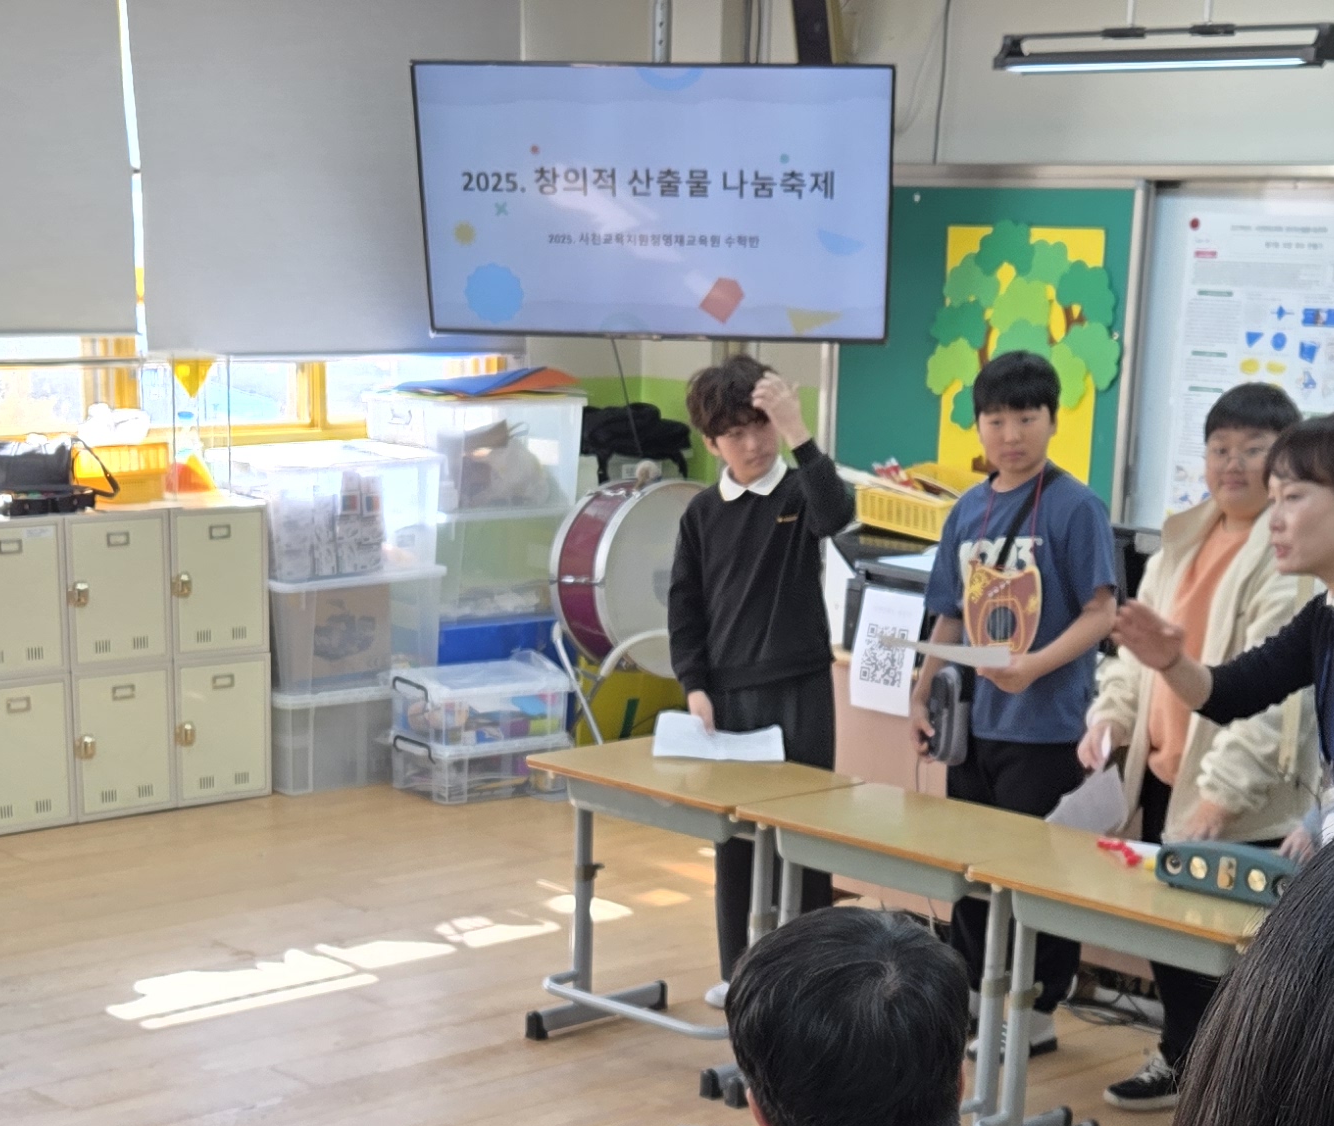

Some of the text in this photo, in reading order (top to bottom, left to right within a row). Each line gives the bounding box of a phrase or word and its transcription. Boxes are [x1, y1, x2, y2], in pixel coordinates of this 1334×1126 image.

[462, 166, 835, 200] 2025. 창의적 산출물 나눔축제
